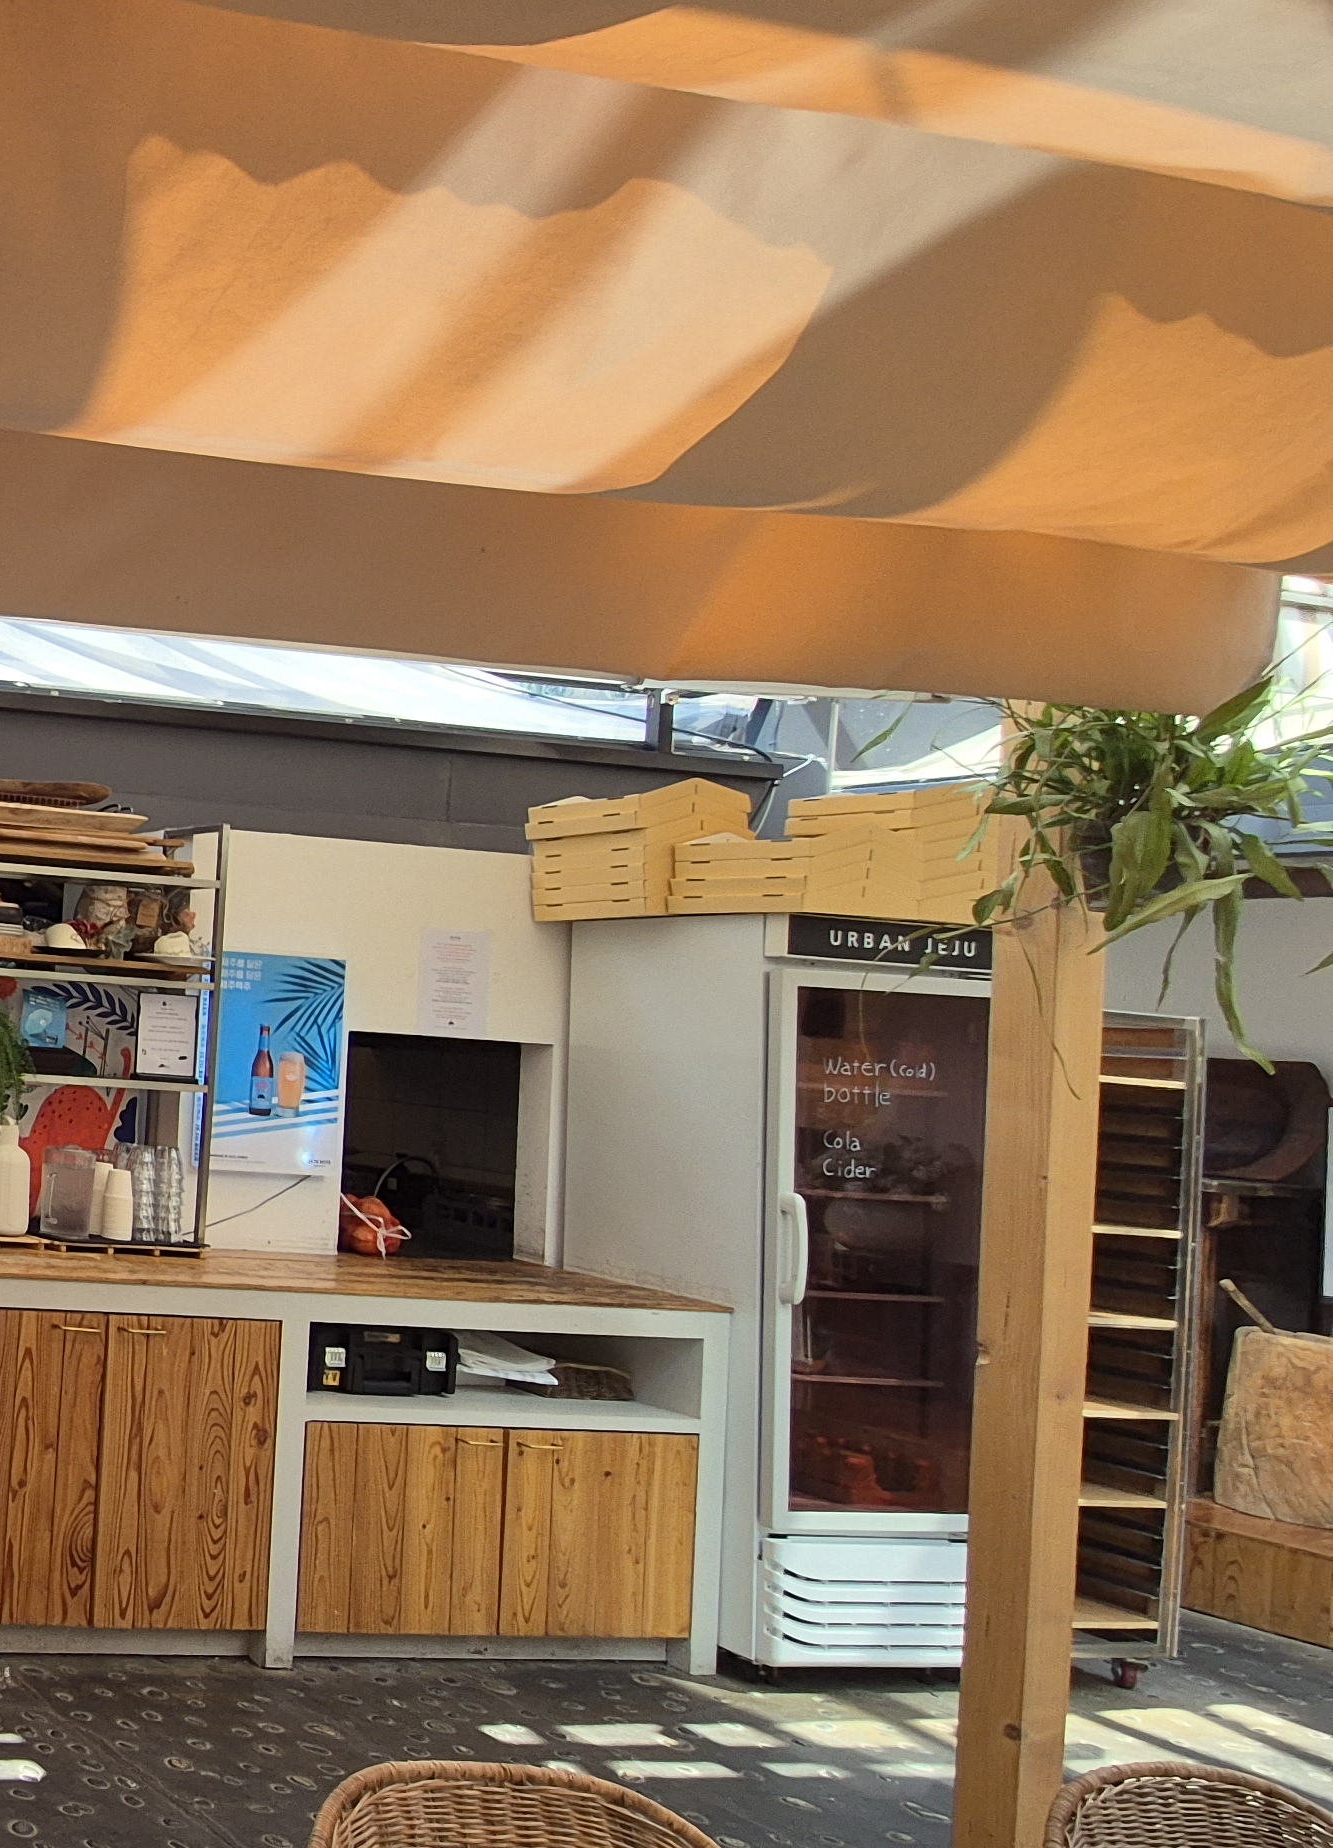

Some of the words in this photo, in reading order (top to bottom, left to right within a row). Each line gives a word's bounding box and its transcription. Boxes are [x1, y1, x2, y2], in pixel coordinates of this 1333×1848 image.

[829, 929, 911, 952] URBAN
[924, 937, 976, 957] JEJU
[823, 1080, 891, 1108] bottle
[823, 1129, 861, 1152] Cola
[822, 1158, 877, 1179] Cider
